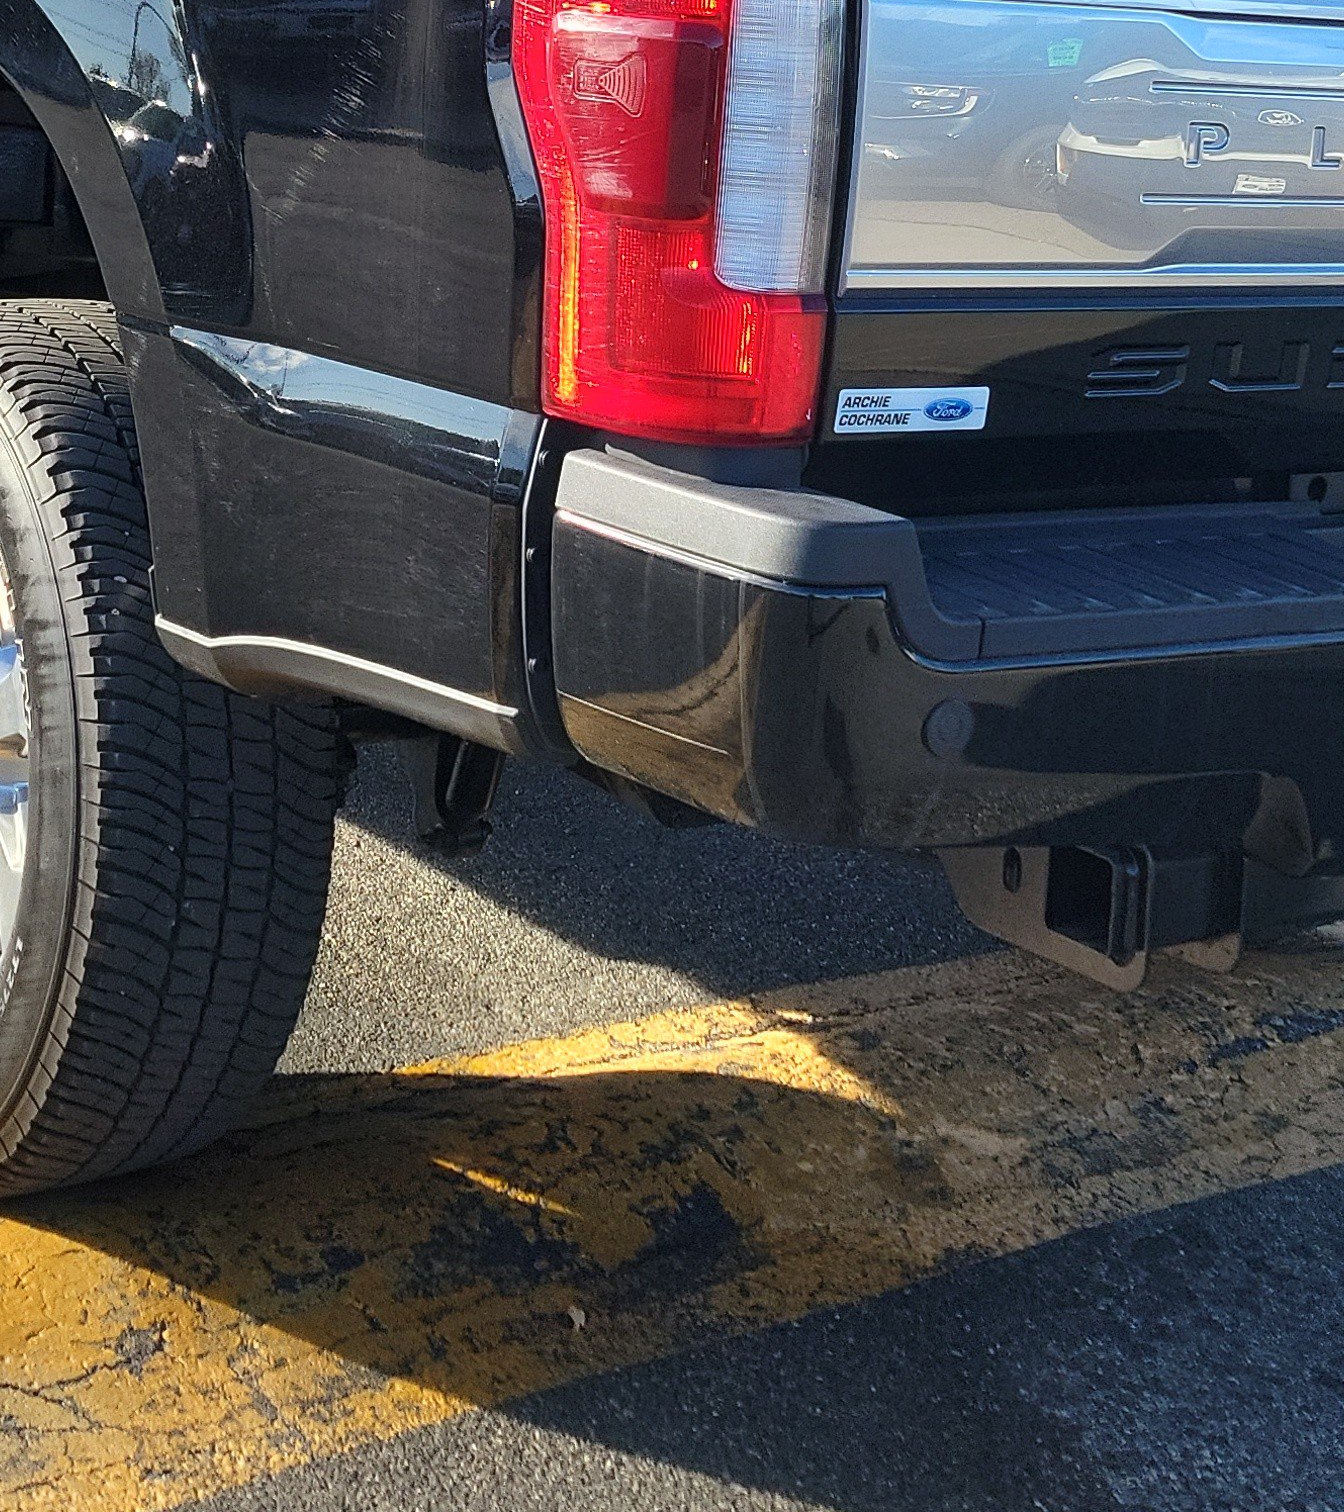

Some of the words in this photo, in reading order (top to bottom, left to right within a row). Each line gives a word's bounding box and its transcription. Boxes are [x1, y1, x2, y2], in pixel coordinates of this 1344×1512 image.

[842, 396, 892, 409] ARCHIE
[932, 400, 962, 418] Ford
[839, 413, 911, 426] COCHRANE
